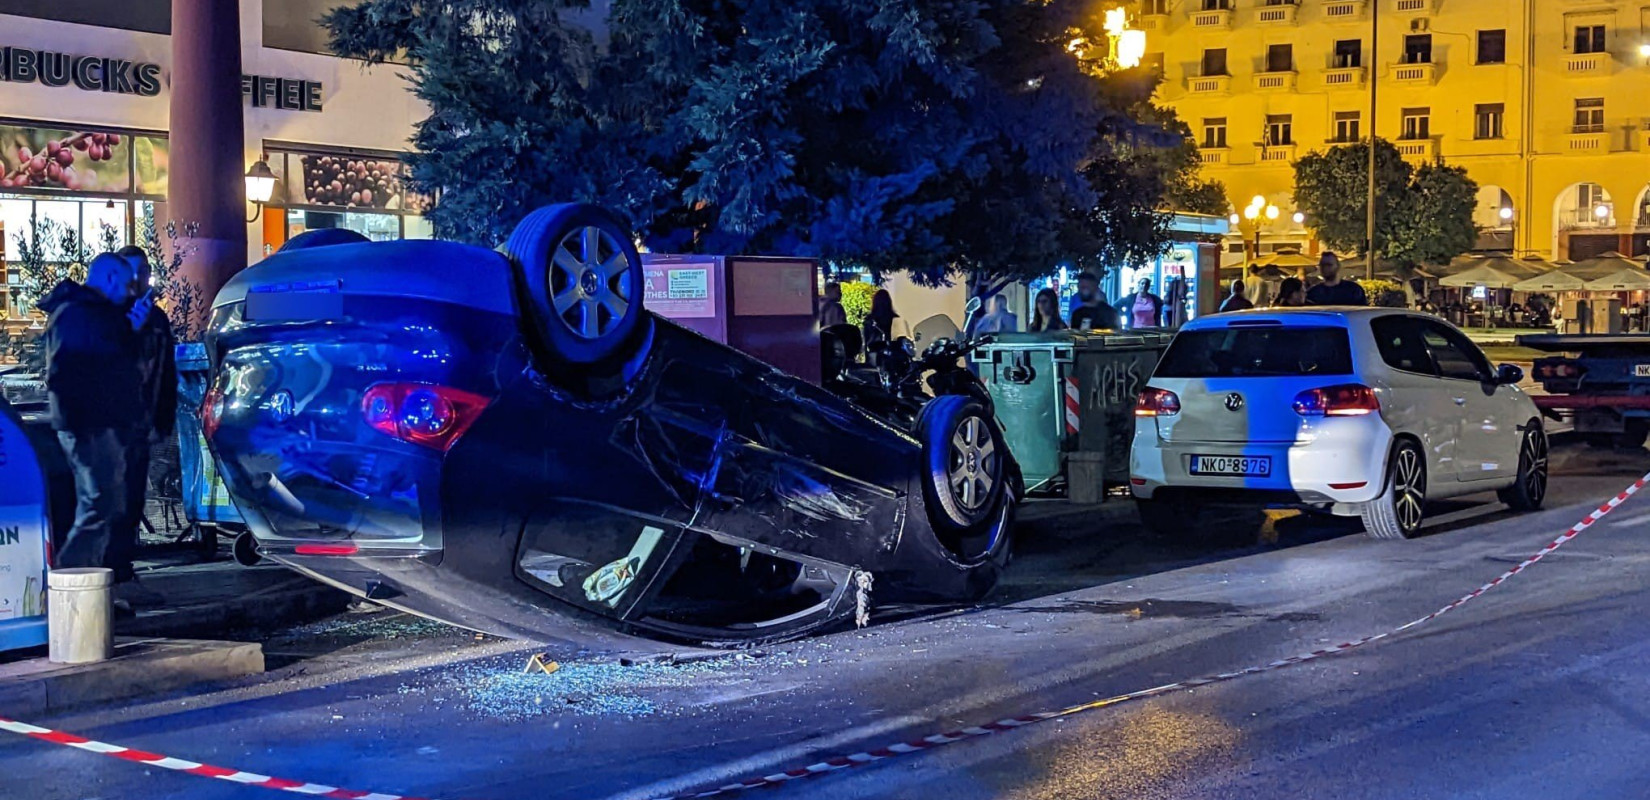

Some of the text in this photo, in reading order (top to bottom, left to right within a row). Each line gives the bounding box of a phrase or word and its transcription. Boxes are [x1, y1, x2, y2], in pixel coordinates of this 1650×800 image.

[0, 46, 323, 112] BUCKS FFEE
[644, 291, 667, 299] THES
